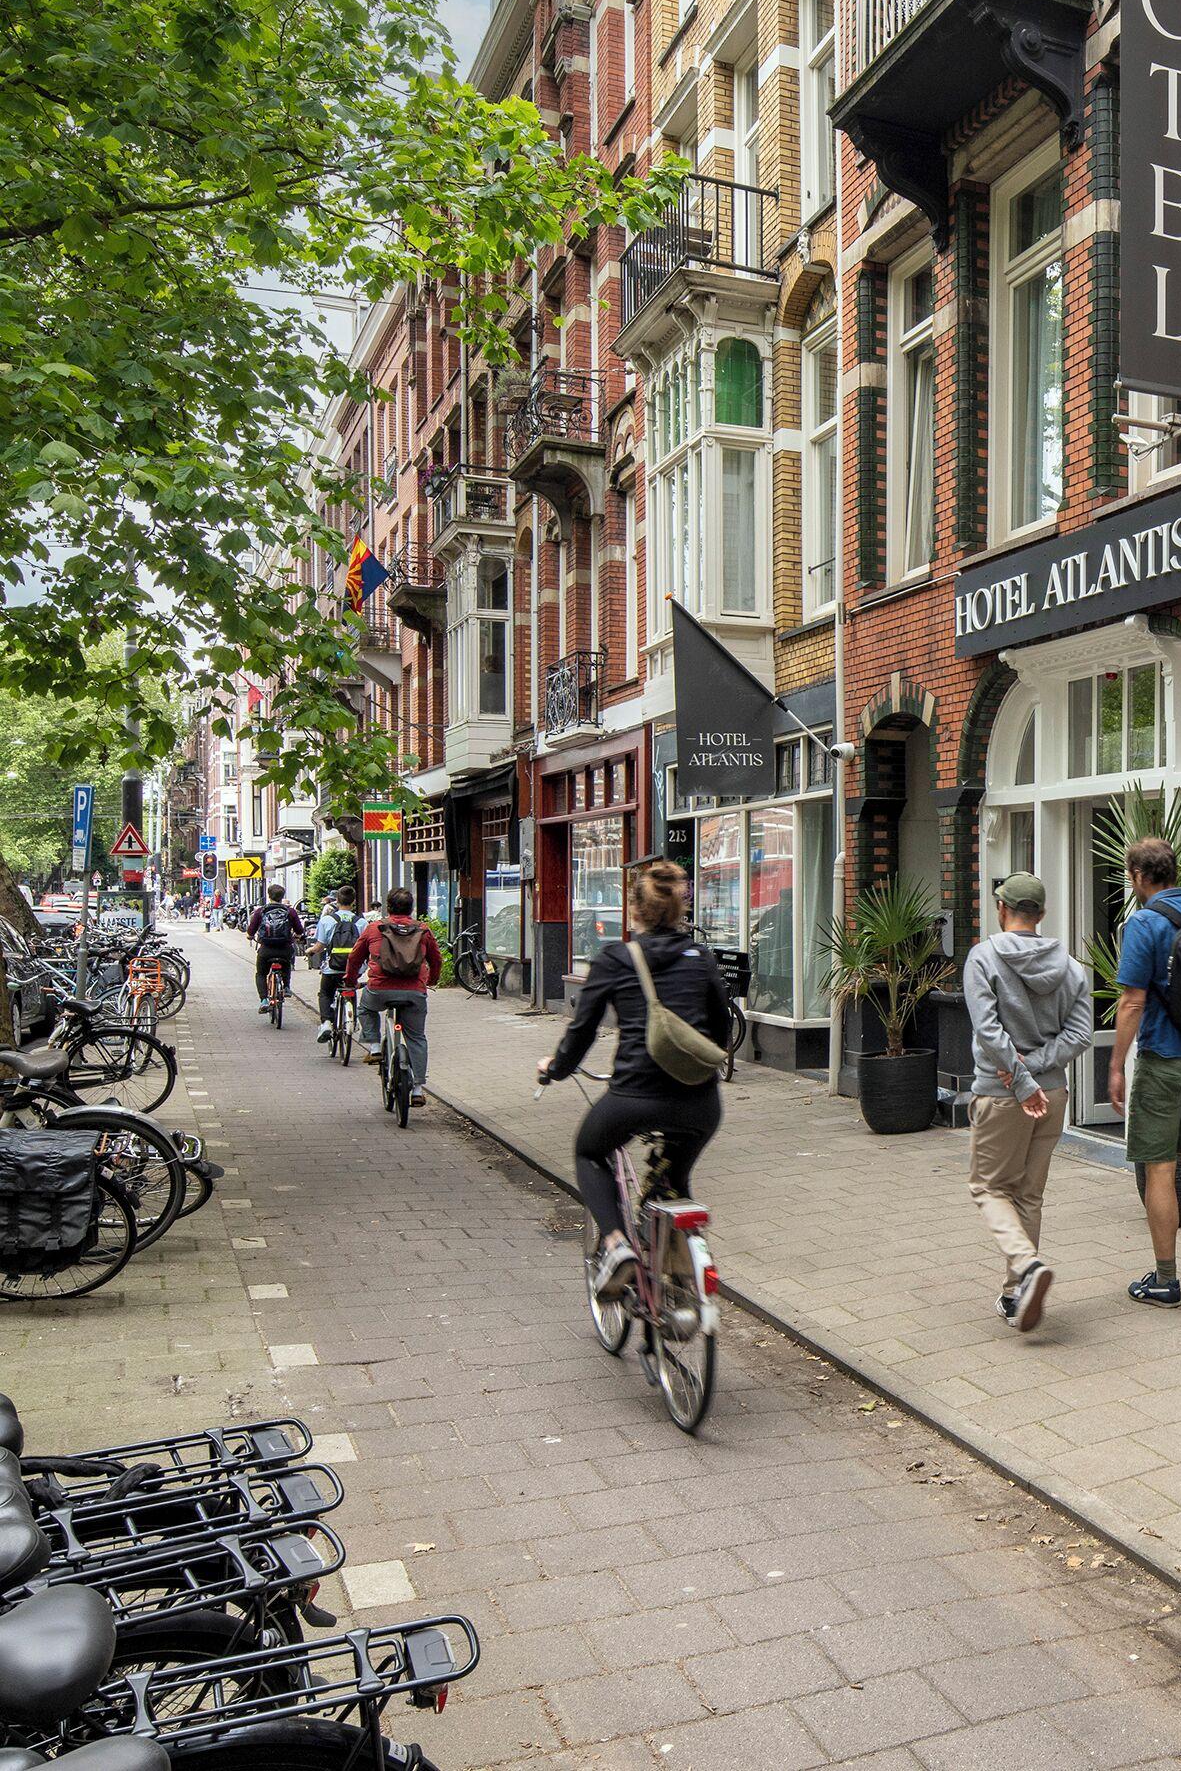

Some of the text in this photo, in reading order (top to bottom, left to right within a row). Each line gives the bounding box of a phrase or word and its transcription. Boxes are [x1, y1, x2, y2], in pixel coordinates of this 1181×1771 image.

[954, 572, 1036, 638] HOTEL
[699, 732, 751, 746] HOTEL
[688, 752, 764, 767] ATLANTIS
[77, 790, 87, 822] P
[668, 829, 687, 843] 213
